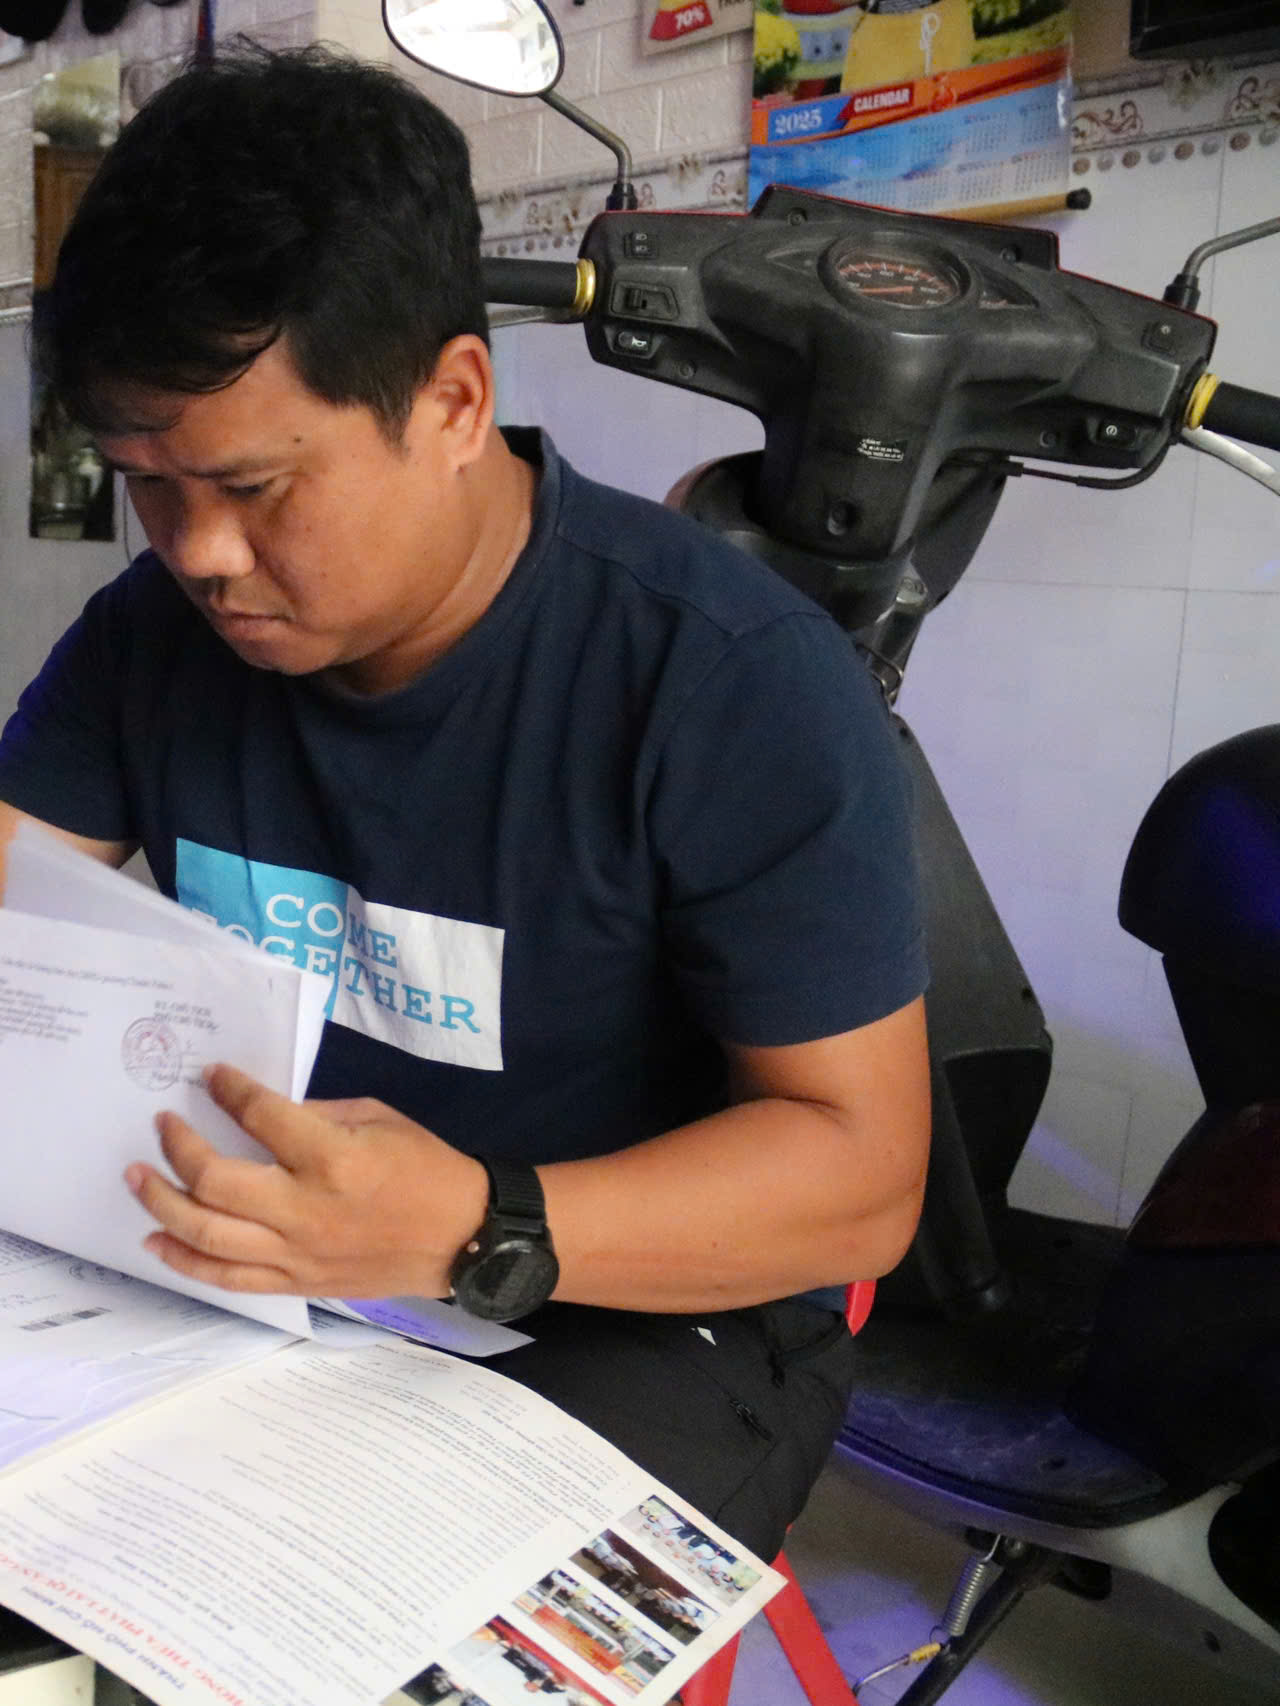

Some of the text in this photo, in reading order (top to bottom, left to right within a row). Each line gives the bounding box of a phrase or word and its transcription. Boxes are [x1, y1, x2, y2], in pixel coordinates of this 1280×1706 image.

[675, 4, 705, 30] 70%
[775, 87, 910, 135] 2025 CALENDAR
[266, 893, 397, 969] COME
[192, 908, 481, 1034] GETHER
